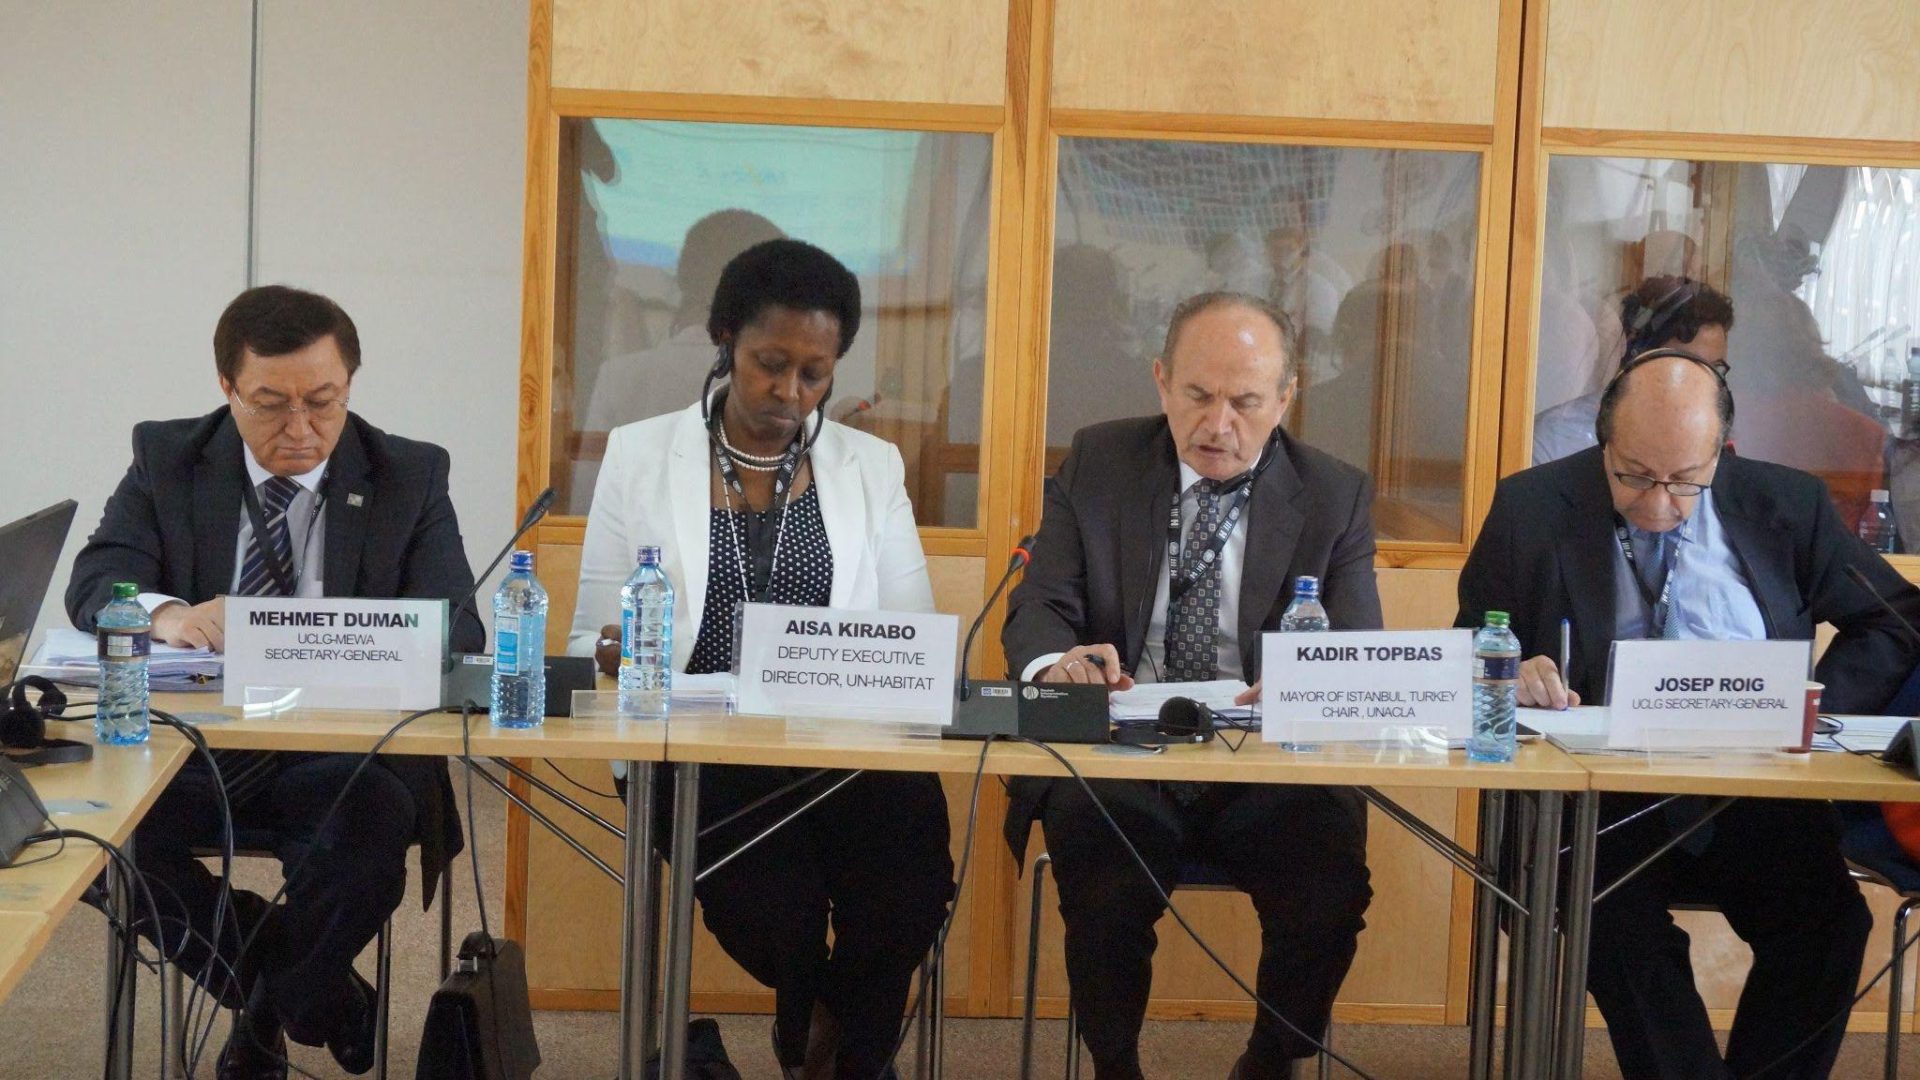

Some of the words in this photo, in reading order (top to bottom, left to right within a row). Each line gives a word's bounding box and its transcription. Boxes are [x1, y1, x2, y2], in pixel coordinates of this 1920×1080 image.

[250, 611, 338, 626] MEHMET
[344, 612, 419, 628] DUMAN
[785, 620, 833, 637] AISA
[838, 622, 916, 640] KIRABO
[297, 633, 375, 645] UCLG-MEWA
[265, 648, 402, 661] SECRETARY-GENERAL
[778, 645, 839, 661] DEPUTY
[842, 649, 925, 665] EXECUTIVE
[1297, 646, 1359, 661] KADIR
[1364, 646, 1443, 661] TOPBAS
[762, 669, 843, 688] DIRECTOR,
[846, 673, 935, 690] UN-HABITAT
[1654, 677, 1714, 692] JOSEP
[1719, 677, 1764, 692] ROIG
[1280, 691, 1325, 702] MAYOR
[1327, 691, 1344, 702] OF
[1409, 691, 1457, 702] TURKEY
[1632, 698, 1663, 710] UCLG
[1665, 699, 1788, 710] SECRETARY-GENERAL
[1367, 706, 1416, 718] UNACLA
